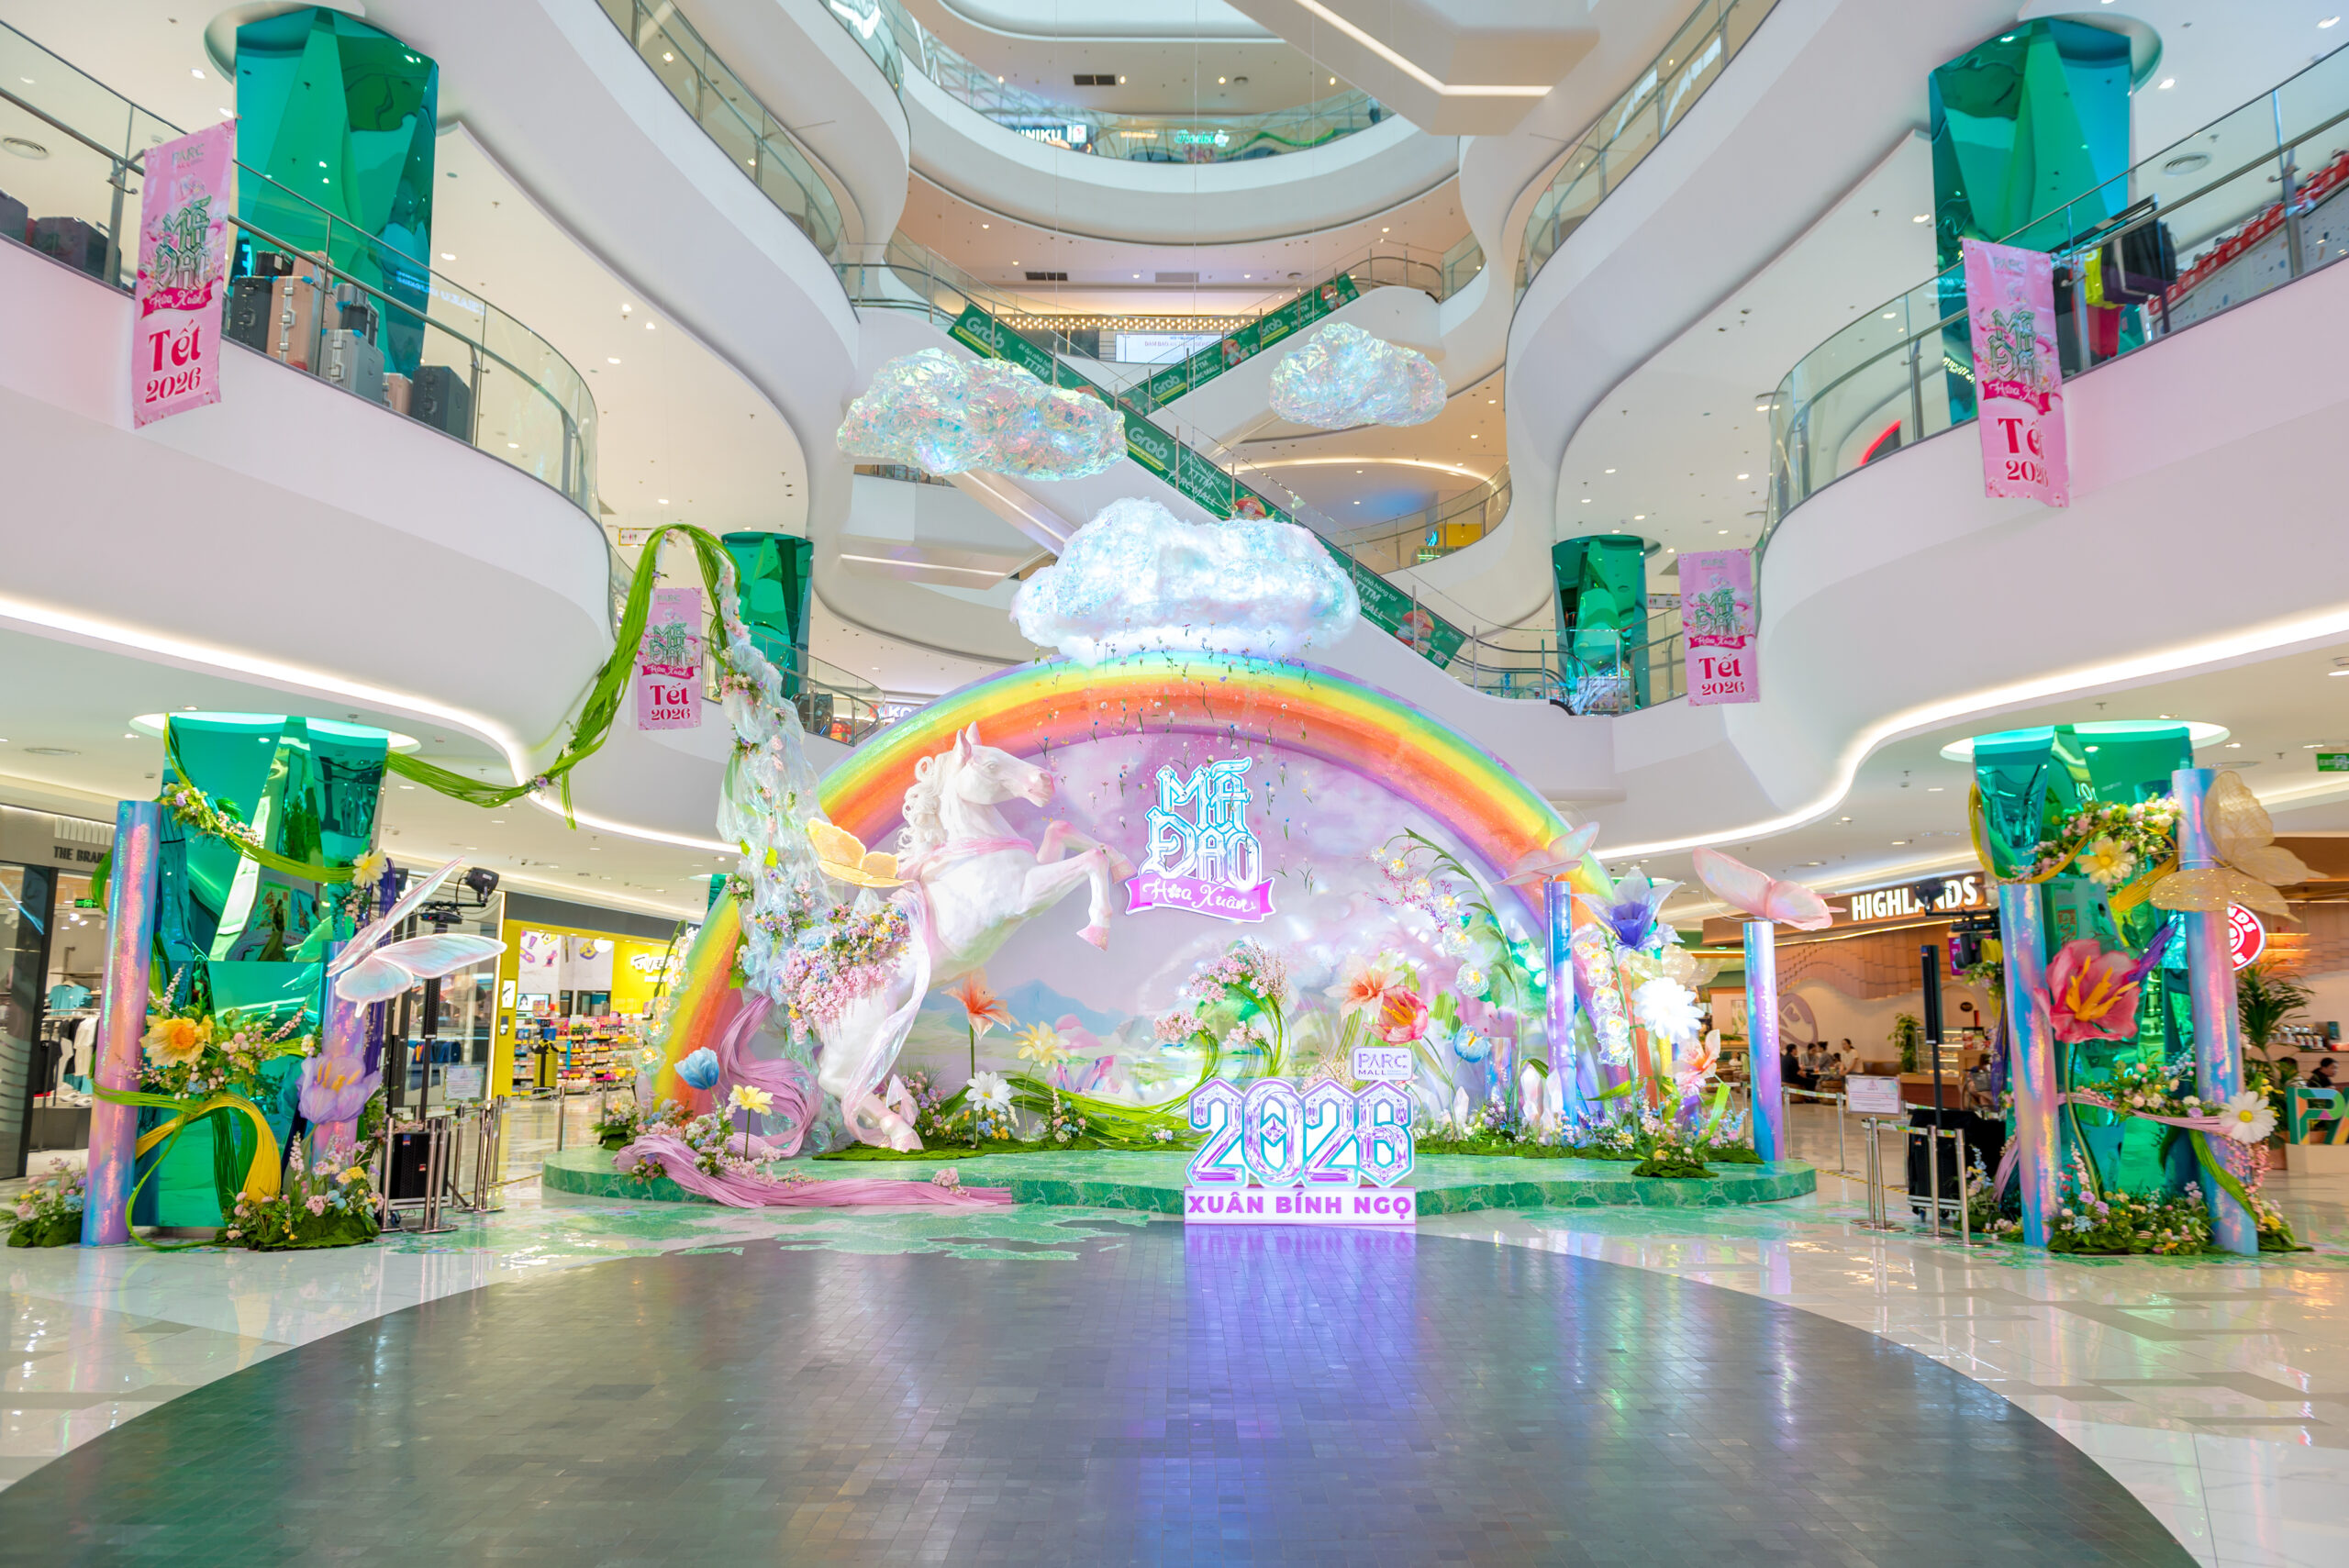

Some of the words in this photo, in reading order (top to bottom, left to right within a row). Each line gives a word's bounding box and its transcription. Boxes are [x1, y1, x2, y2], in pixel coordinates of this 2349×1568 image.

[148, 318, 201, 373] Tết
[965, 317, 1005, 350] Grab
[1024, 356, 1051, 378] TTTM
[145, 367, 201, 404] 2026
[1152, 373, 1181, 395] Grab
[1129, 427, 1168, 460] Grab
[1698, 653, 1742, 680] Tết
[650, 683, 689, 706] Tết
[1701, 681, 1745, 696] 2026
[651, 708, 691, 721] 2026
[53, 846, 73, 861] THE
[1142, 877, 1192, 904] Hoa
[1191, 884, 1257, 912] Xuân
[1358, 1052, 1408, 1069] PARC
[1186, 1078, 1414, 1187] 2026
[1187, 1191, 1264, 1214] XUÂN
[1275, 1192, 1342, 1214] BÍNH
[1353, 1196, 1412, 1220] NGỌ
